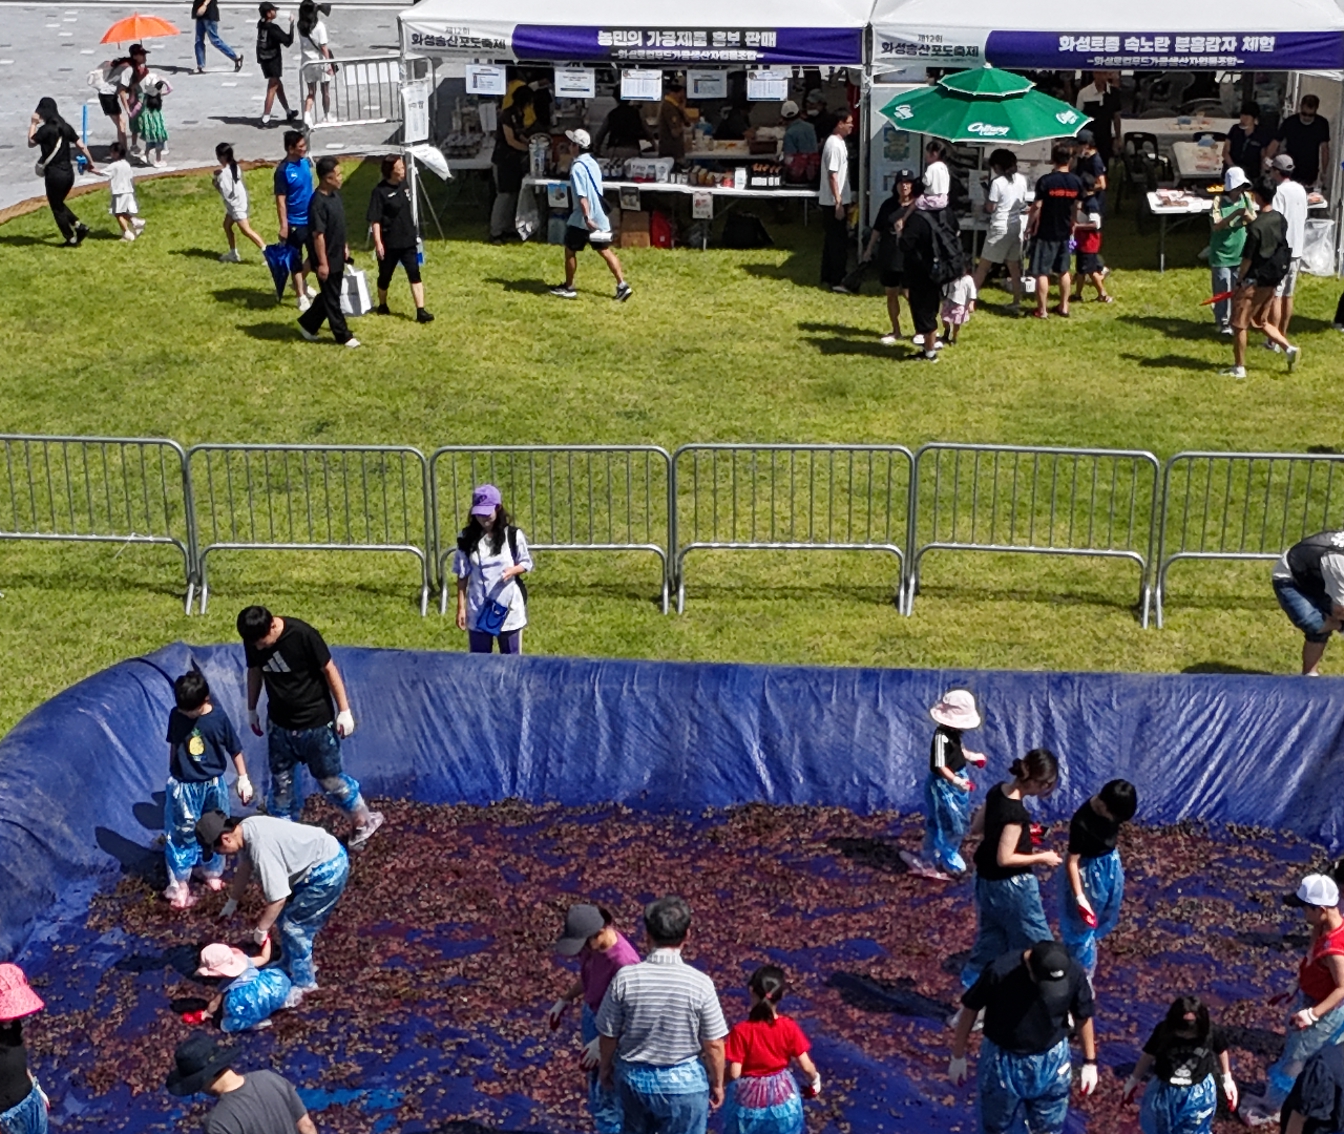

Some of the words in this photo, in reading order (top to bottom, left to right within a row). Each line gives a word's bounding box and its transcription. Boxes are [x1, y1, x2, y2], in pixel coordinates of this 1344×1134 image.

[411, 33, 506, 50] 화성송산포도축제
[597, 30, 643, 47] 농민의
[712, 31, 740, 47] 홍보
[745, 31, 777, 47] 판매
[918, 34, 943, 43] 제12회
[1241, 36, 1275, 52] 체험
[881, 41, 979, 57] 화성송산포도축제
